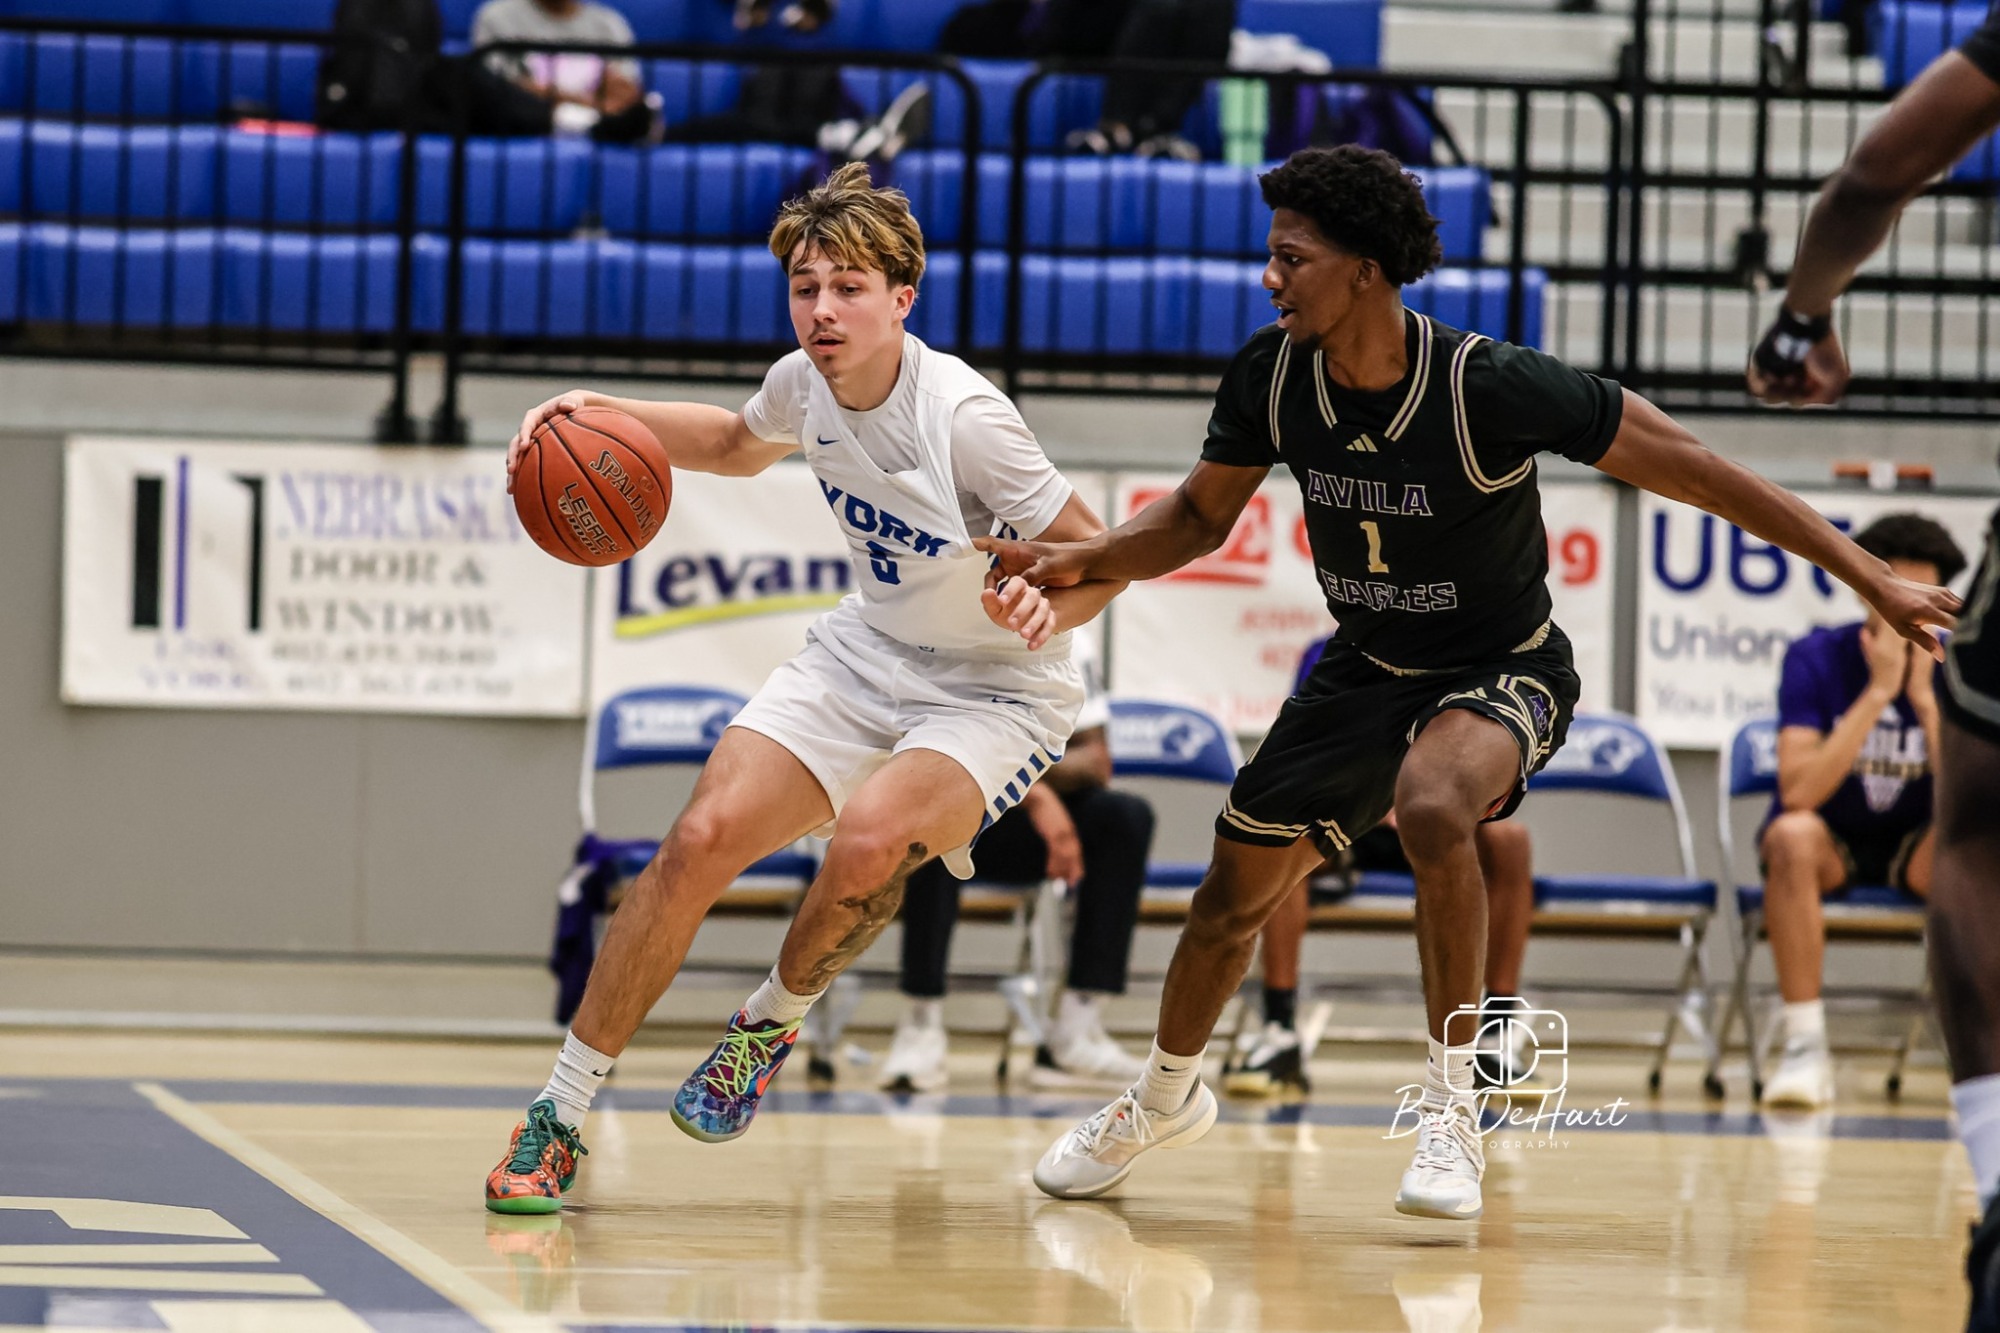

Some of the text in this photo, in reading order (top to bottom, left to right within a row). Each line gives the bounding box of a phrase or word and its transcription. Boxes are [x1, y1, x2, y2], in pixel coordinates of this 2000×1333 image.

[563, 481, 622, 554] LEGACY
[817, 476, 951, 557] YORK
[1308, 468, 1433, 517] AVILA
[289, 550, 438, 586] DOOR
[1359, 520, 1390, 573] 1
[1320, 567, 1458, 613] EAGLES
